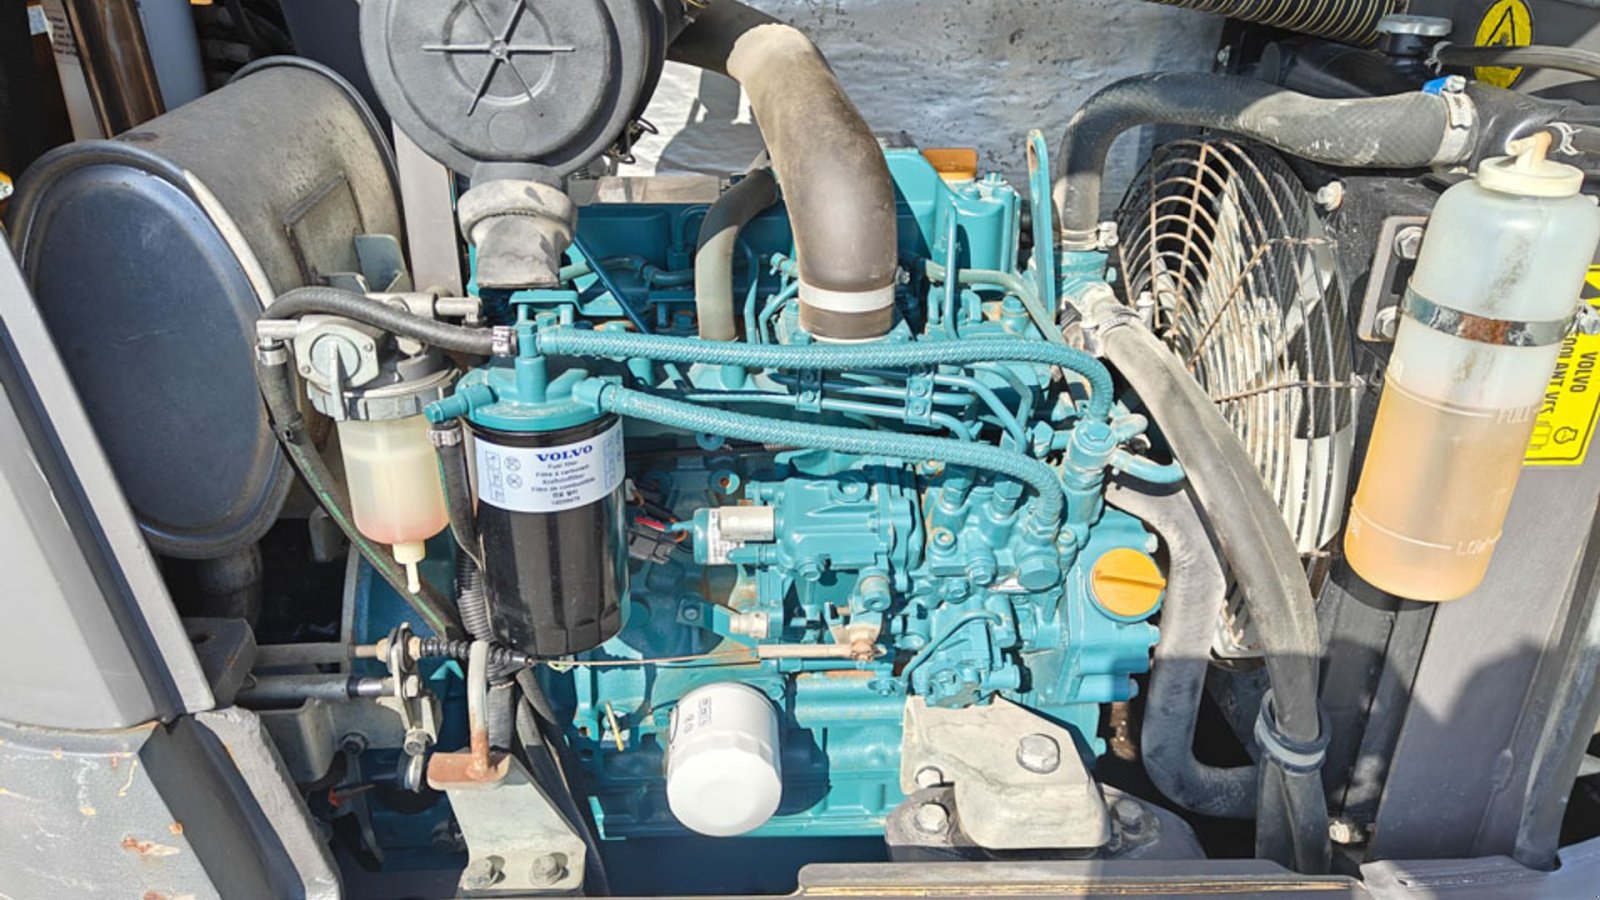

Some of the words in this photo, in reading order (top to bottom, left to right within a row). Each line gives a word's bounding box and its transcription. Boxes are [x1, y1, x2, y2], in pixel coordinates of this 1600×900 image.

[1549, 331, 1578, 387] OOLANT
[1569, 351, 1599, 393] VOLVO
[1497, 404, 1531, 425] FULL
[536, 445, 592, 462] VOLVO
